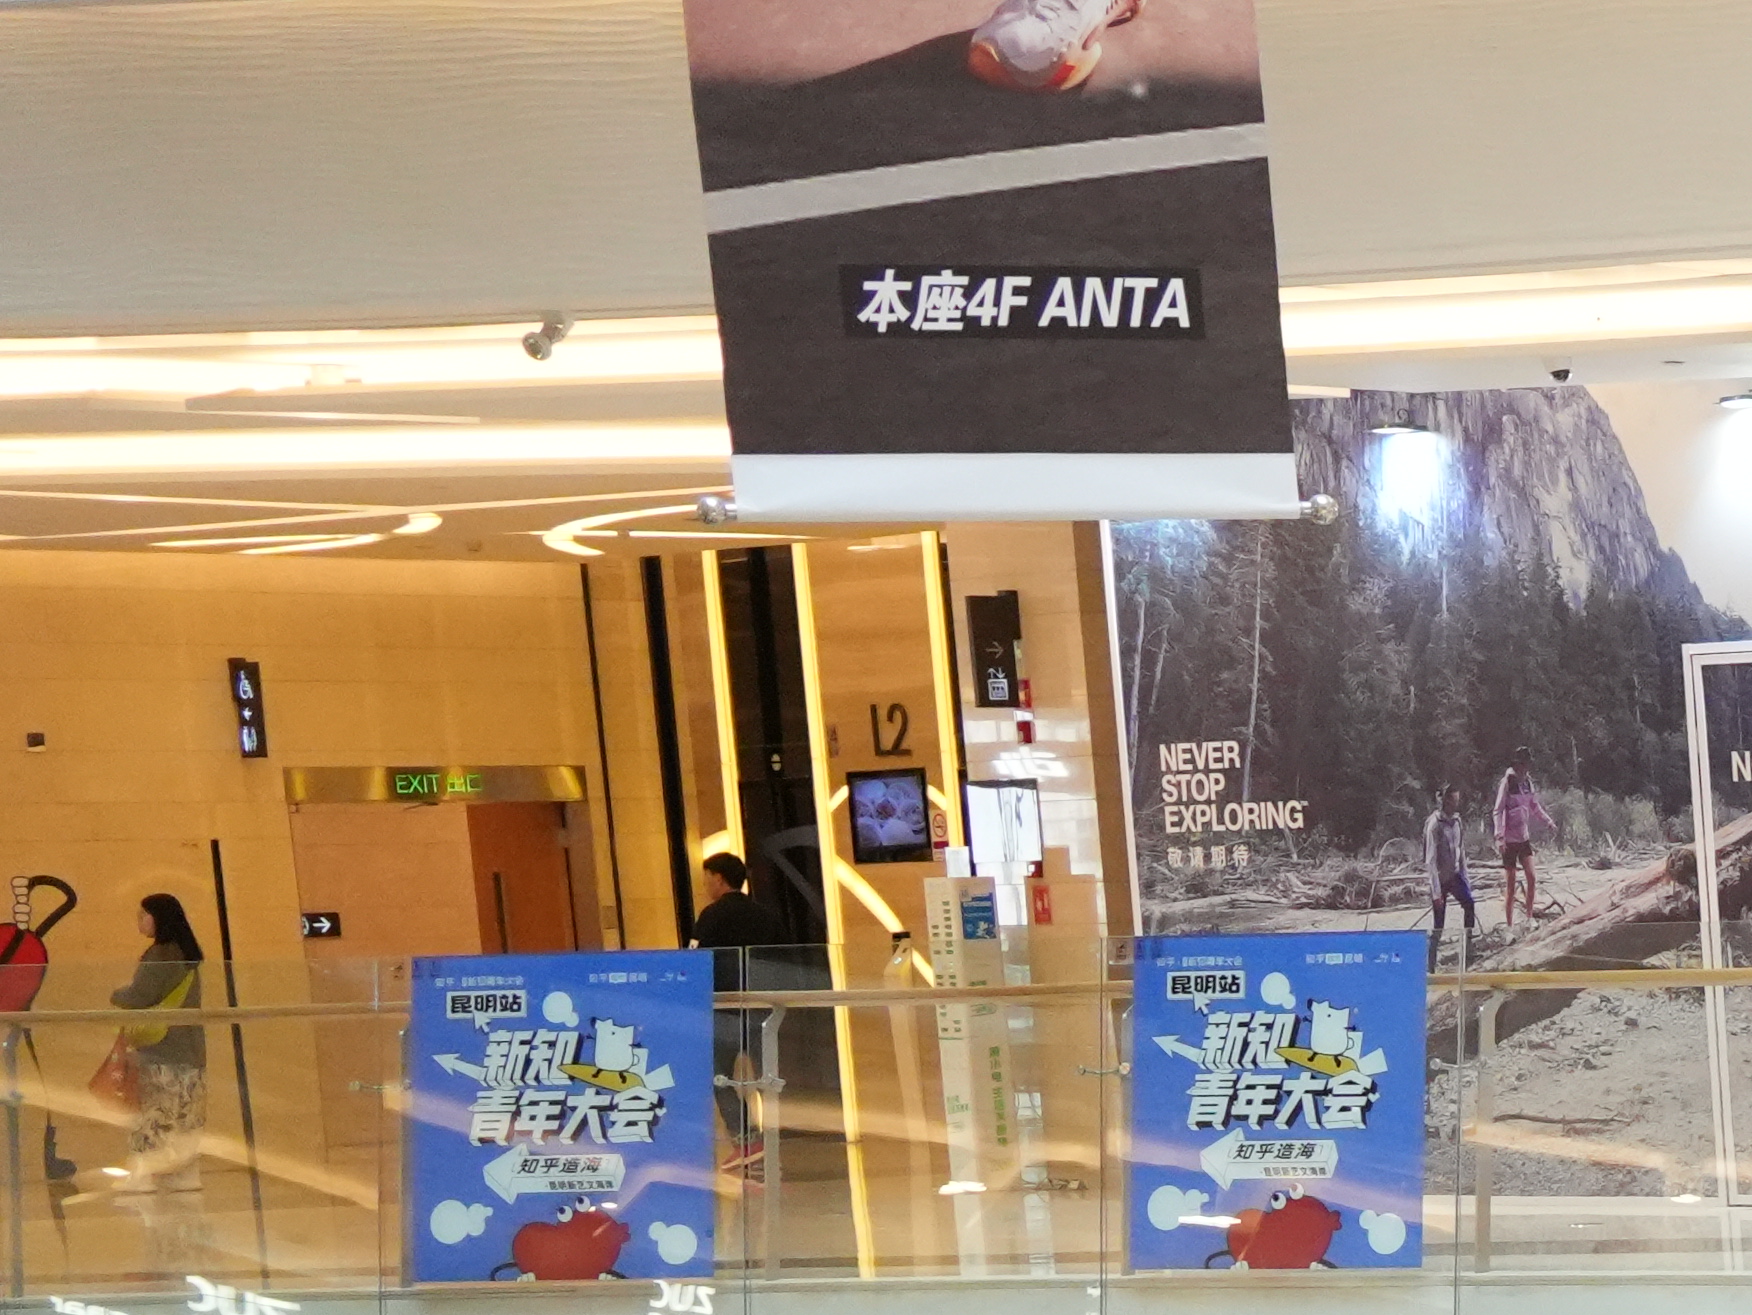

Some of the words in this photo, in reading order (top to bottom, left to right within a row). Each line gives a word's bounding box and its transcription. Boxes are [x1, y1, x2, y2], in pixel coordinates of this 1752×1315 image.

[856, 271, 1029, 334] 本座4F
[1037, 275, 1192, 331] ANTA
[871, 703, 912, 757] L2
[1159, 741, 1240, 772] NEVER
[395, 774, 439, 794] EXIT
[447, 773, 482, 792] 出口
[1161, 773, 1225, 803] STOP
[1164, 801, 1306, 834] EXPLORING
[1167, 845, 1250, 868] 敬请期待
[1171, 976, 1241, 994] 昆明站
[450, 994, 523, 1014] 昆明站
[1199, 1010, 1296, 1069] 新知
[483, 1029, 580, 1085] 新知
[469, 1086, 660, 1145] 青年大会
[1186, 1070, 1372, 1130] 青年大会
